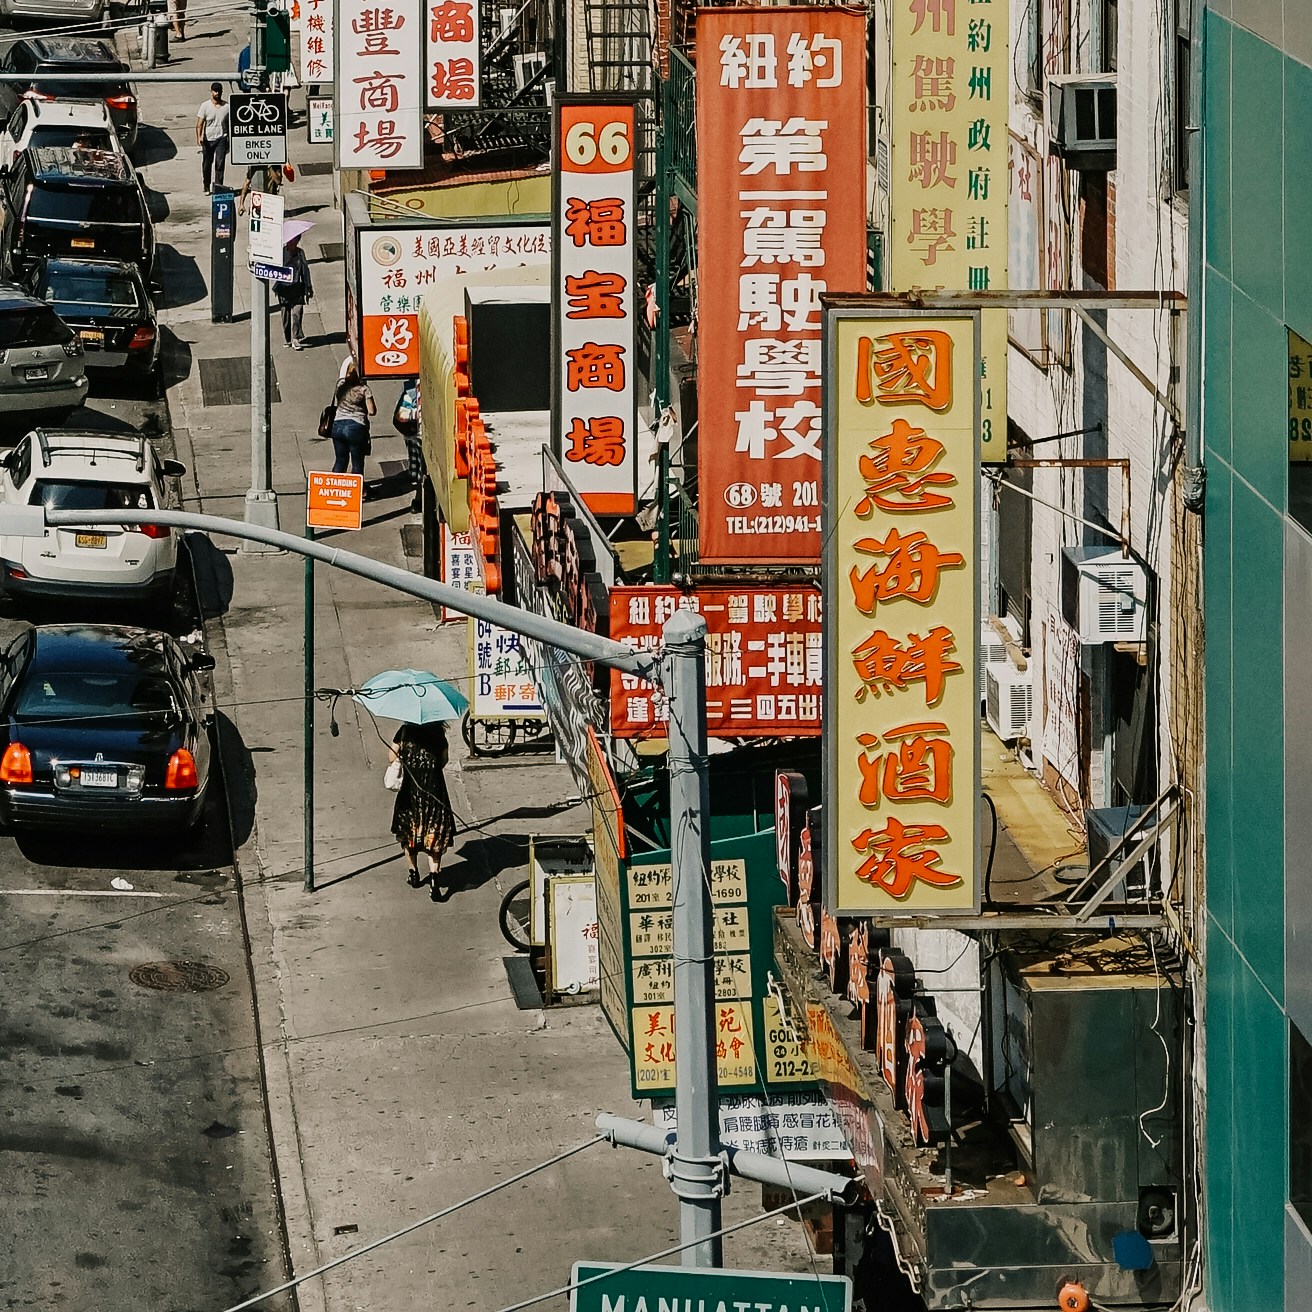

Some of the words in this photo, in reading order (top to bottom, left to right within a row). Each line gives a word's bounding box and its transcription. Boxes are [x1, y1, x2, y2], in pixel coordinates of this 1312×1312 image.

[718, 32, 842, 88] 紐約
[234, 125, 255, 134] BIKE
[257, 124, 283, 134] LANE
[245, 140, 272, 149] BIKES
[564, 120, 630, 166] 66
[246, 151, 270, 160] ONLY
[381, 265, 437, 289] 福州
[734, 118, 827, 459] 第一駕駛學校
[313, 477, 323, 485] NO
[325, 478, 358, 488] STANDING
[318, 488, 353, 498] ANYTIME
[792, 481, 819, 506] 201
[851, 329, 965, 898] 國惠海鮮酒家
[712, 864, 742, 882] 學校
